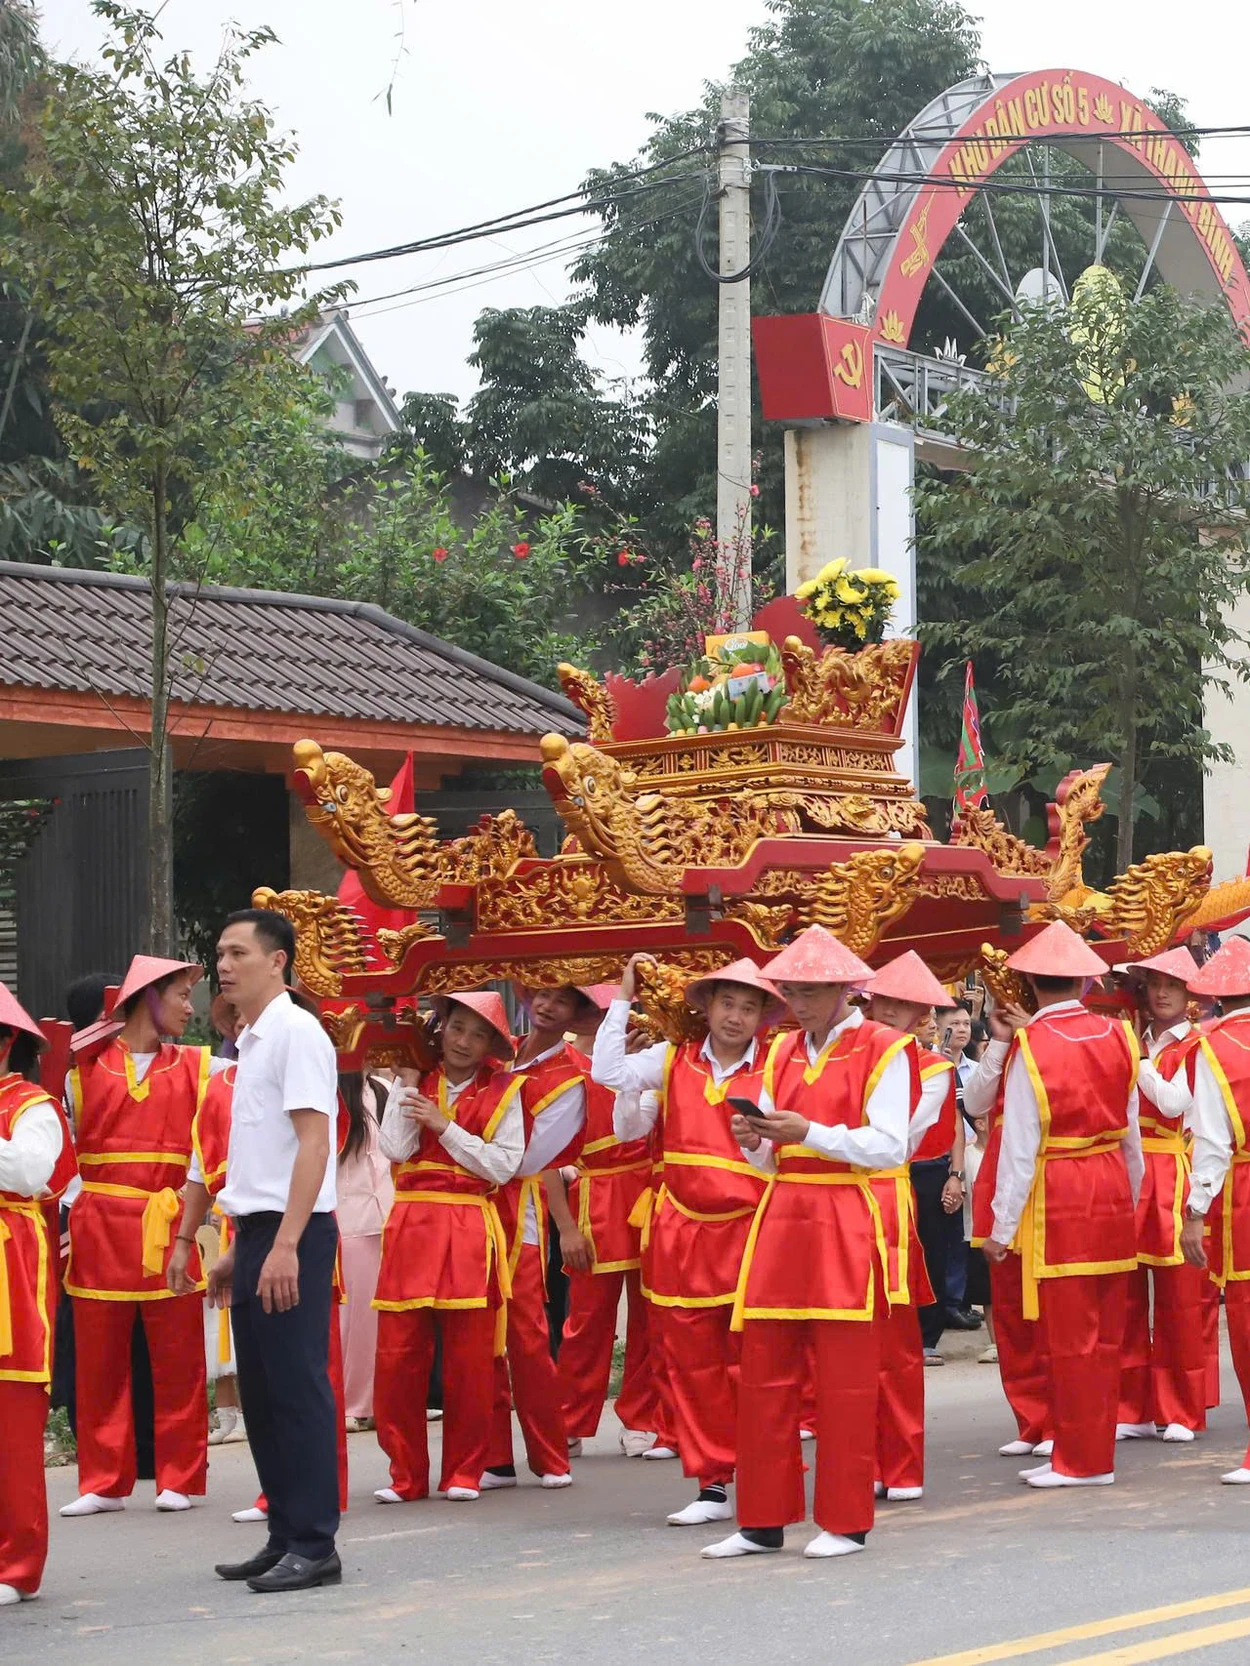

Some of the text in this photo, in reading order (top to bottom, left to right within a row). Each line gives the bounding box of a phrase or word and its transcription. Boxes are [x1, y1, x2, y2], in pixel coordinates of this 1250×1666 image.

[948, 128, 989, 198] KHU
[984, 99, 1026, 160] DÂN
[1024, 80, 1050, 129] CƯ
[1052, 71, 1076, 125] SỐ
[1077, 86, 1090, 126] 5
[1145, 122, 1199, 217] THANH
